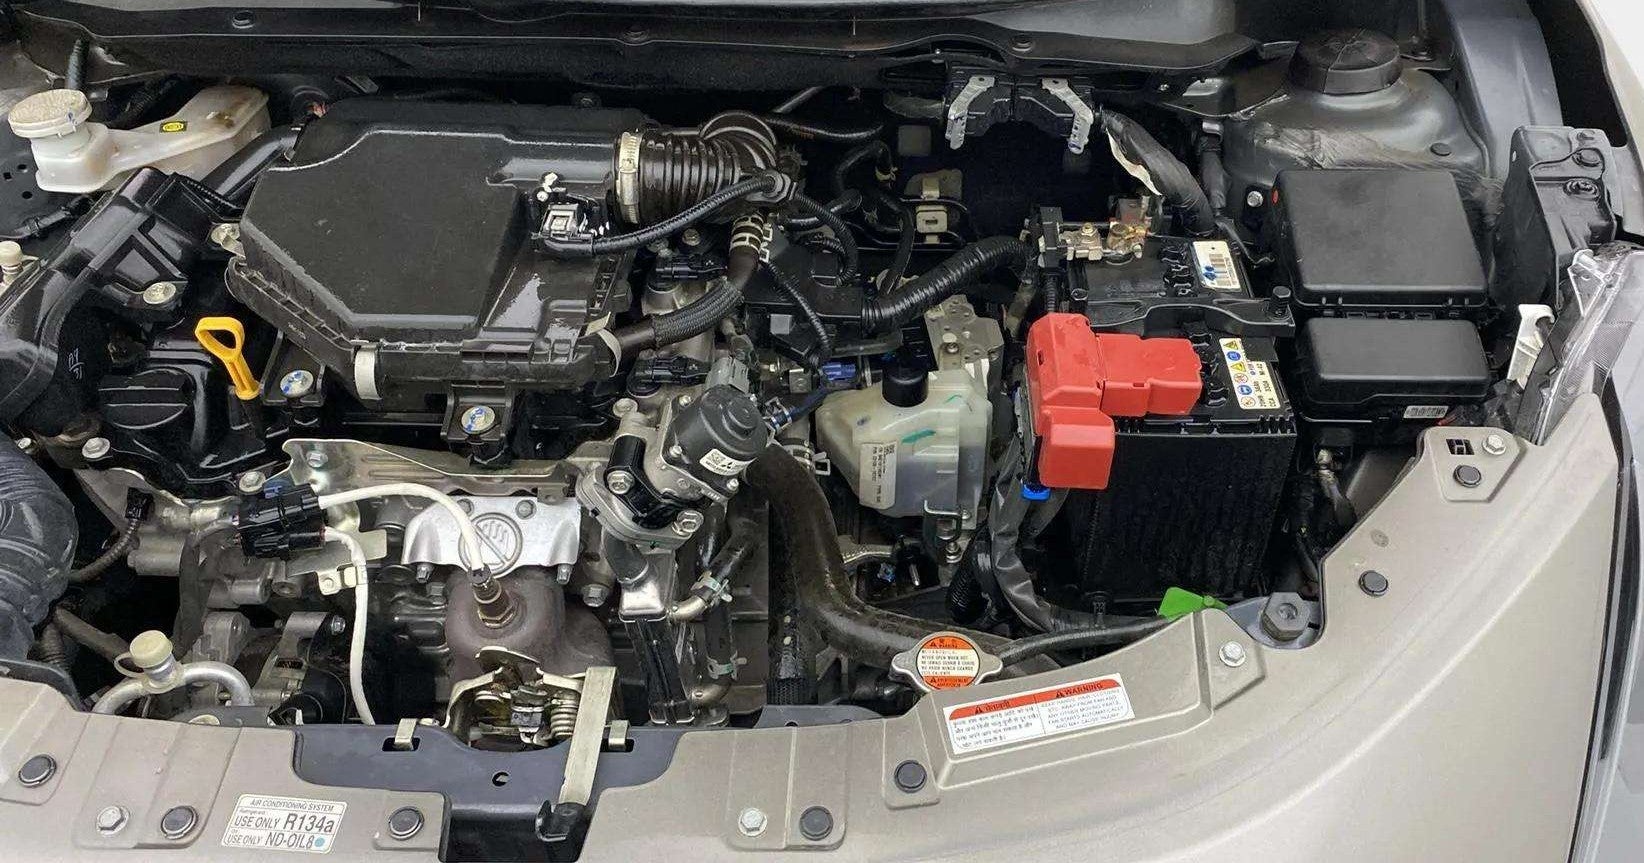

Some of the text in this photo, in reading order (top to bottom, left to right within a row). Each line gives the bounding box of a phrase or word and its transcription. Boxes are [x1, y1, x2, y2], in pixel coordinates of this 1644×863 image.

[1065, 682, 1103, 695] WARNING
[263, 800, 306, 810] CONDITIONING
[308, 803, 334, 812] SYSTEM
[234, 812, 334, 832] USE ONLY R134a
[227, 832, 315, 849] USE ONLY ND-OIL8
